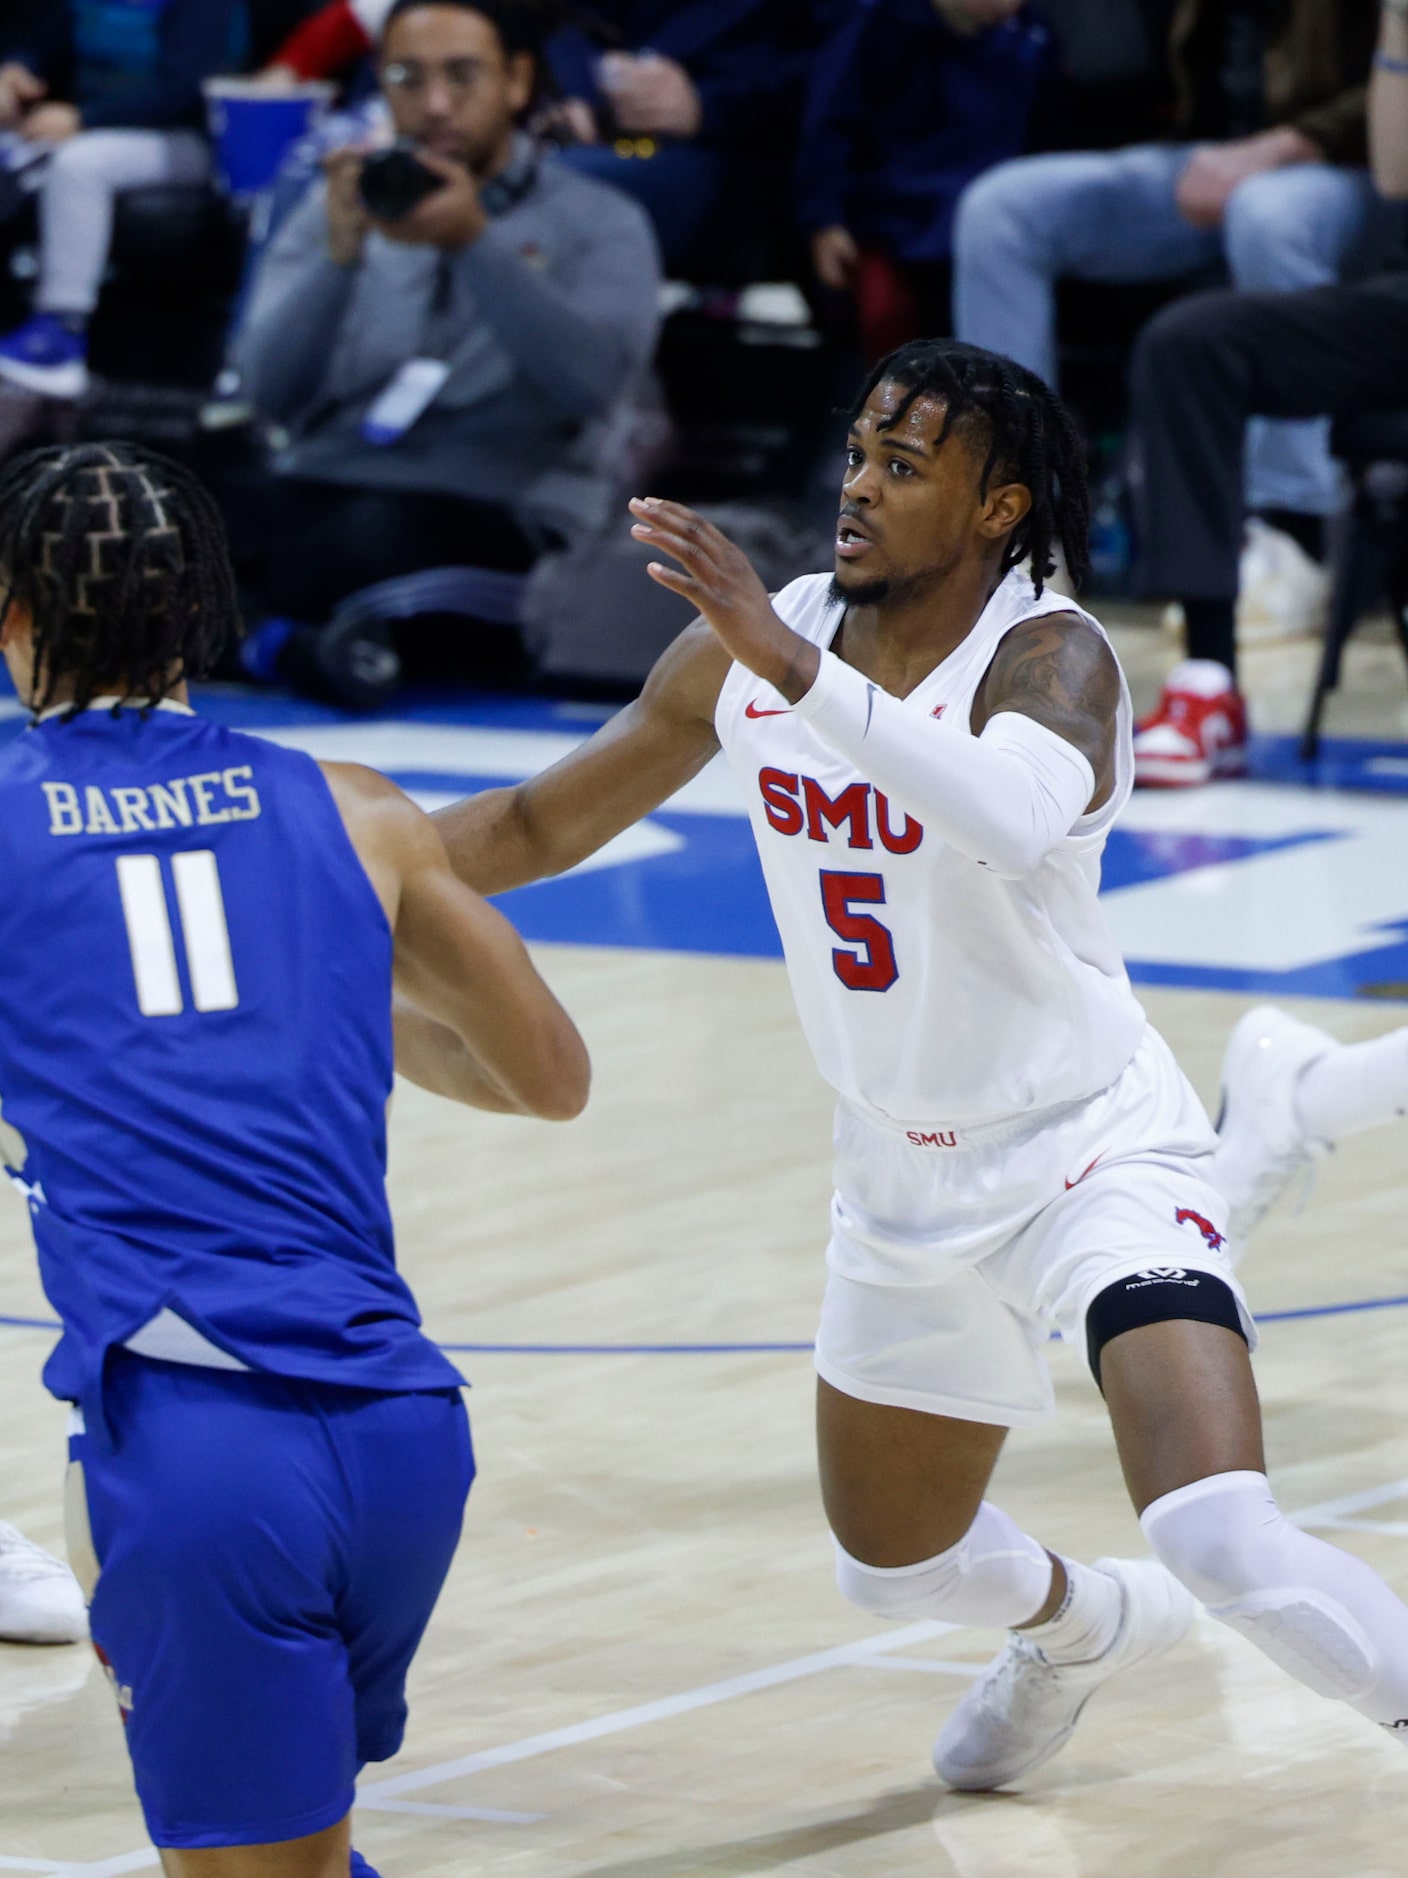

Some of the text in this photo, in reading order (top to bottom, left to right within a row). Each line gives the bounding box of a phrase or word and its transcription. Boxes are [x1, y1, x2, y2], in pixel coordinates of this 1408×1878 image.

[41, 765, 261, 836] BARNES
[758, 766, 924, 855] SMU
[115, 849, 240, 1018] 11
[819, 868, 900, 993] 5
[905, 1130, 957, 1148] SMU
